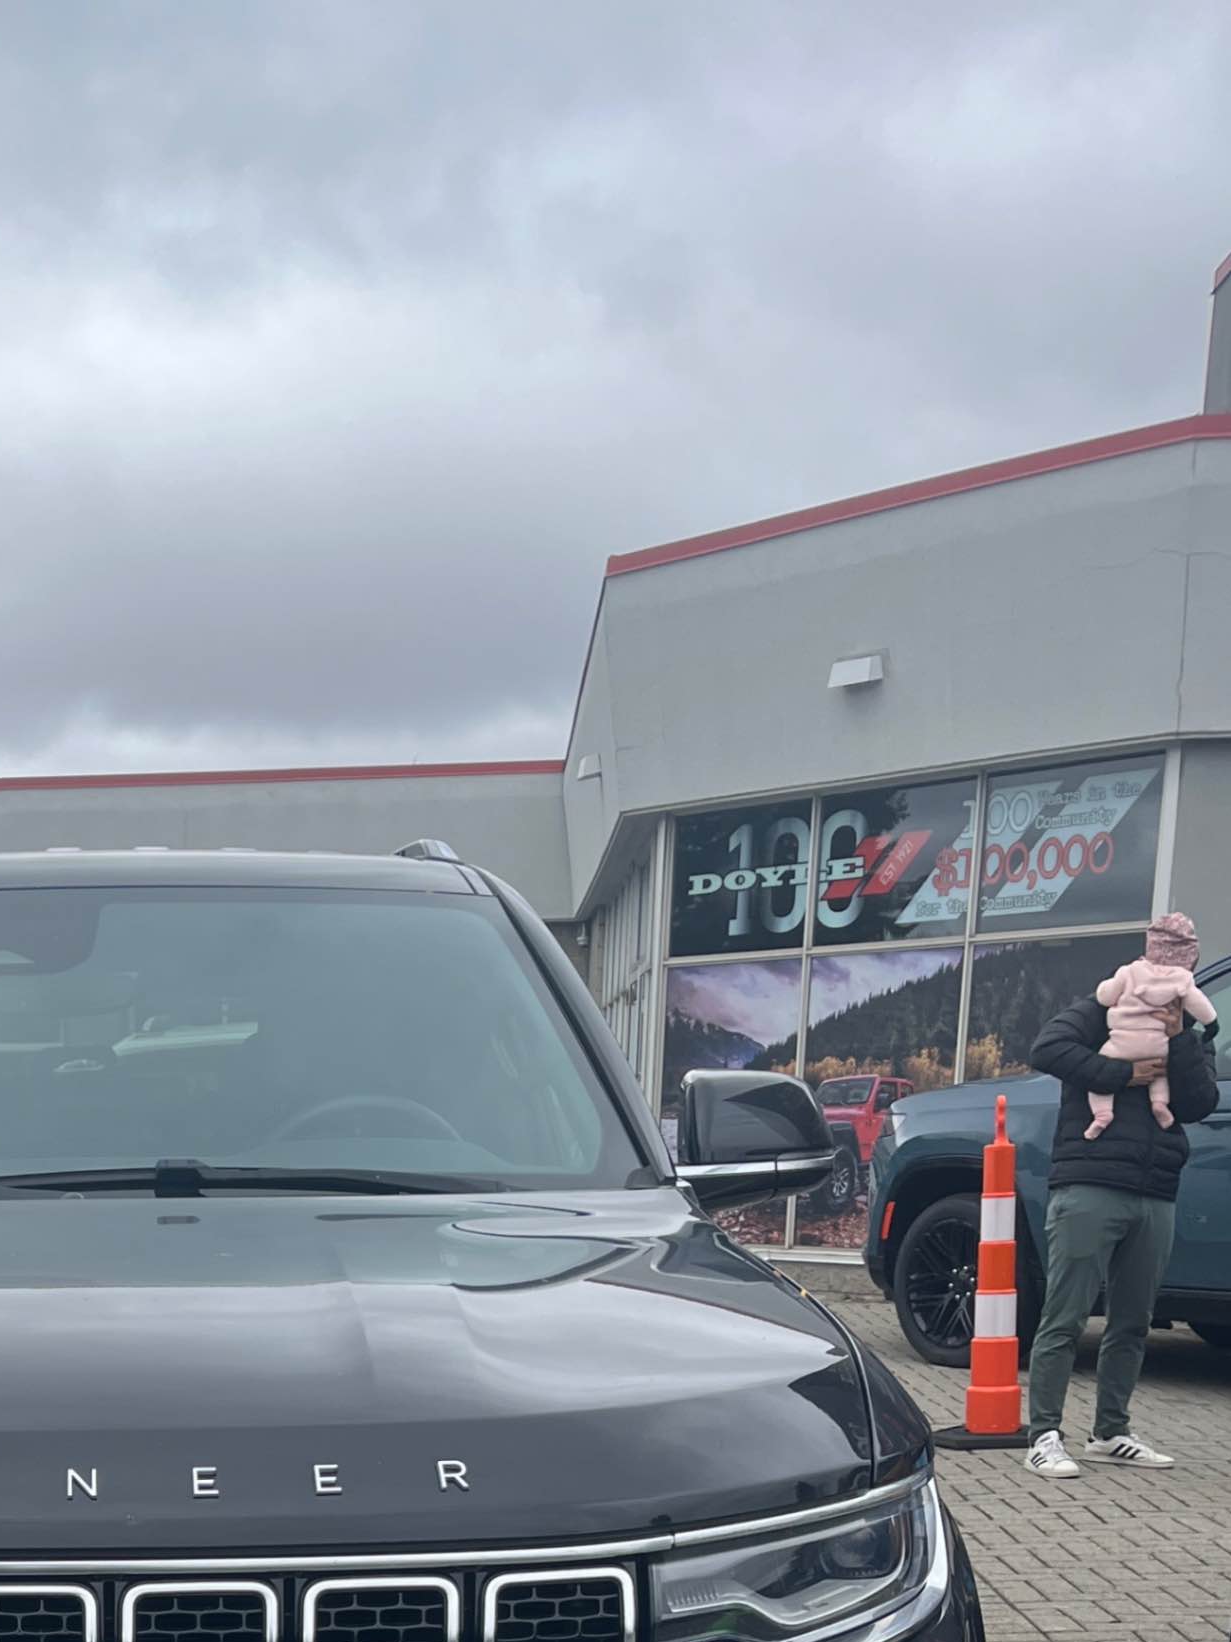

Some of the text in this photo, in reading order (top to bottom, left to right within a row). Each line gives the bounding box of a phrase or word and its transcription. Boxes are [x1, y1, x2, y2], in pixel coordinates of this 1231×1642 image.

[1034, 806, 1117, 830] Community
[688, 856, 865, 895] DOYLE
[932, 831, 1115, 897] $100,000
